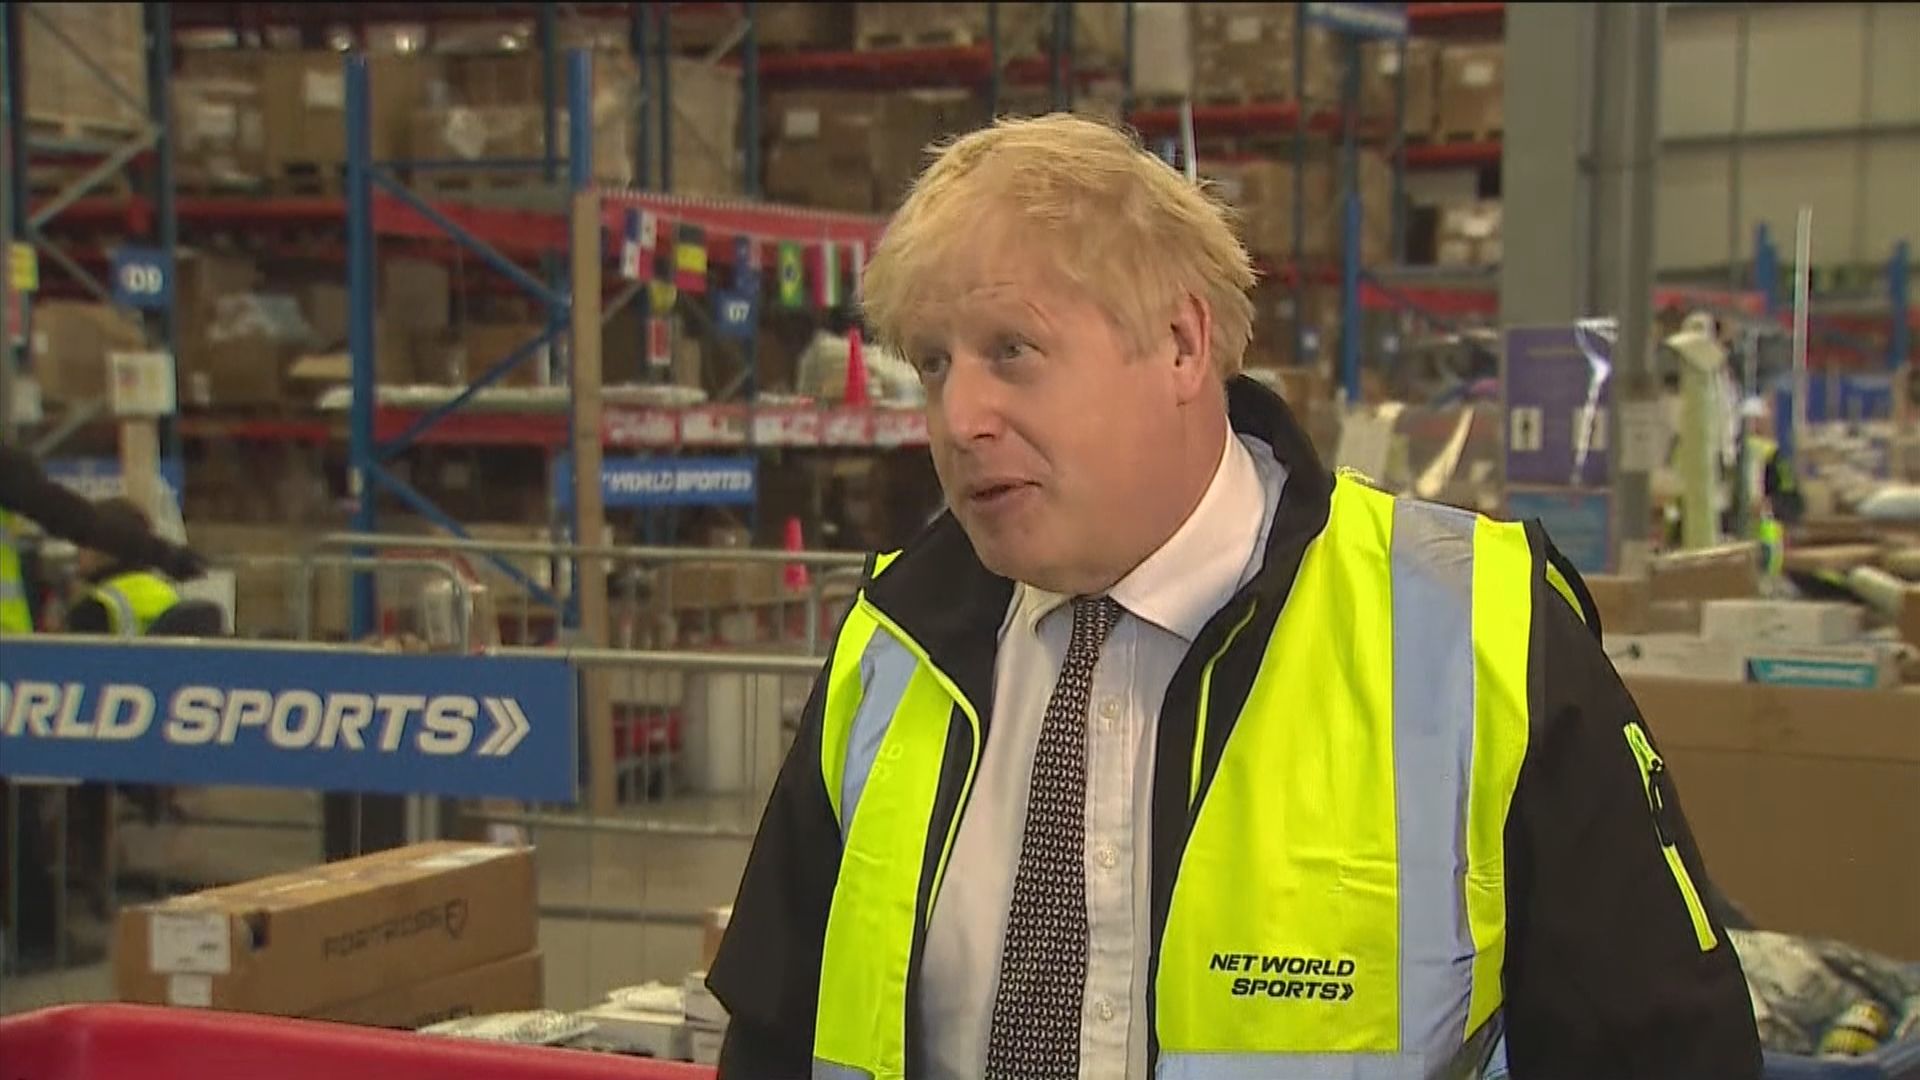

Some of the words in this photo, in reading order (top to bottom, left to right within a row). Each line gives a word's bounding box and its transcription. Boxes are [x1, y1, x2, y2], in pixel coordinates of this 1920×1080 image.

[0, 679, 156, 740] RLD
[165, 686, 480, 755] SPORTS
[1210, 953, 1258, 971] NET
[1262, 956, 1355, 977] WORLD
[1231, 978, 1340, 1000] SPORTS
